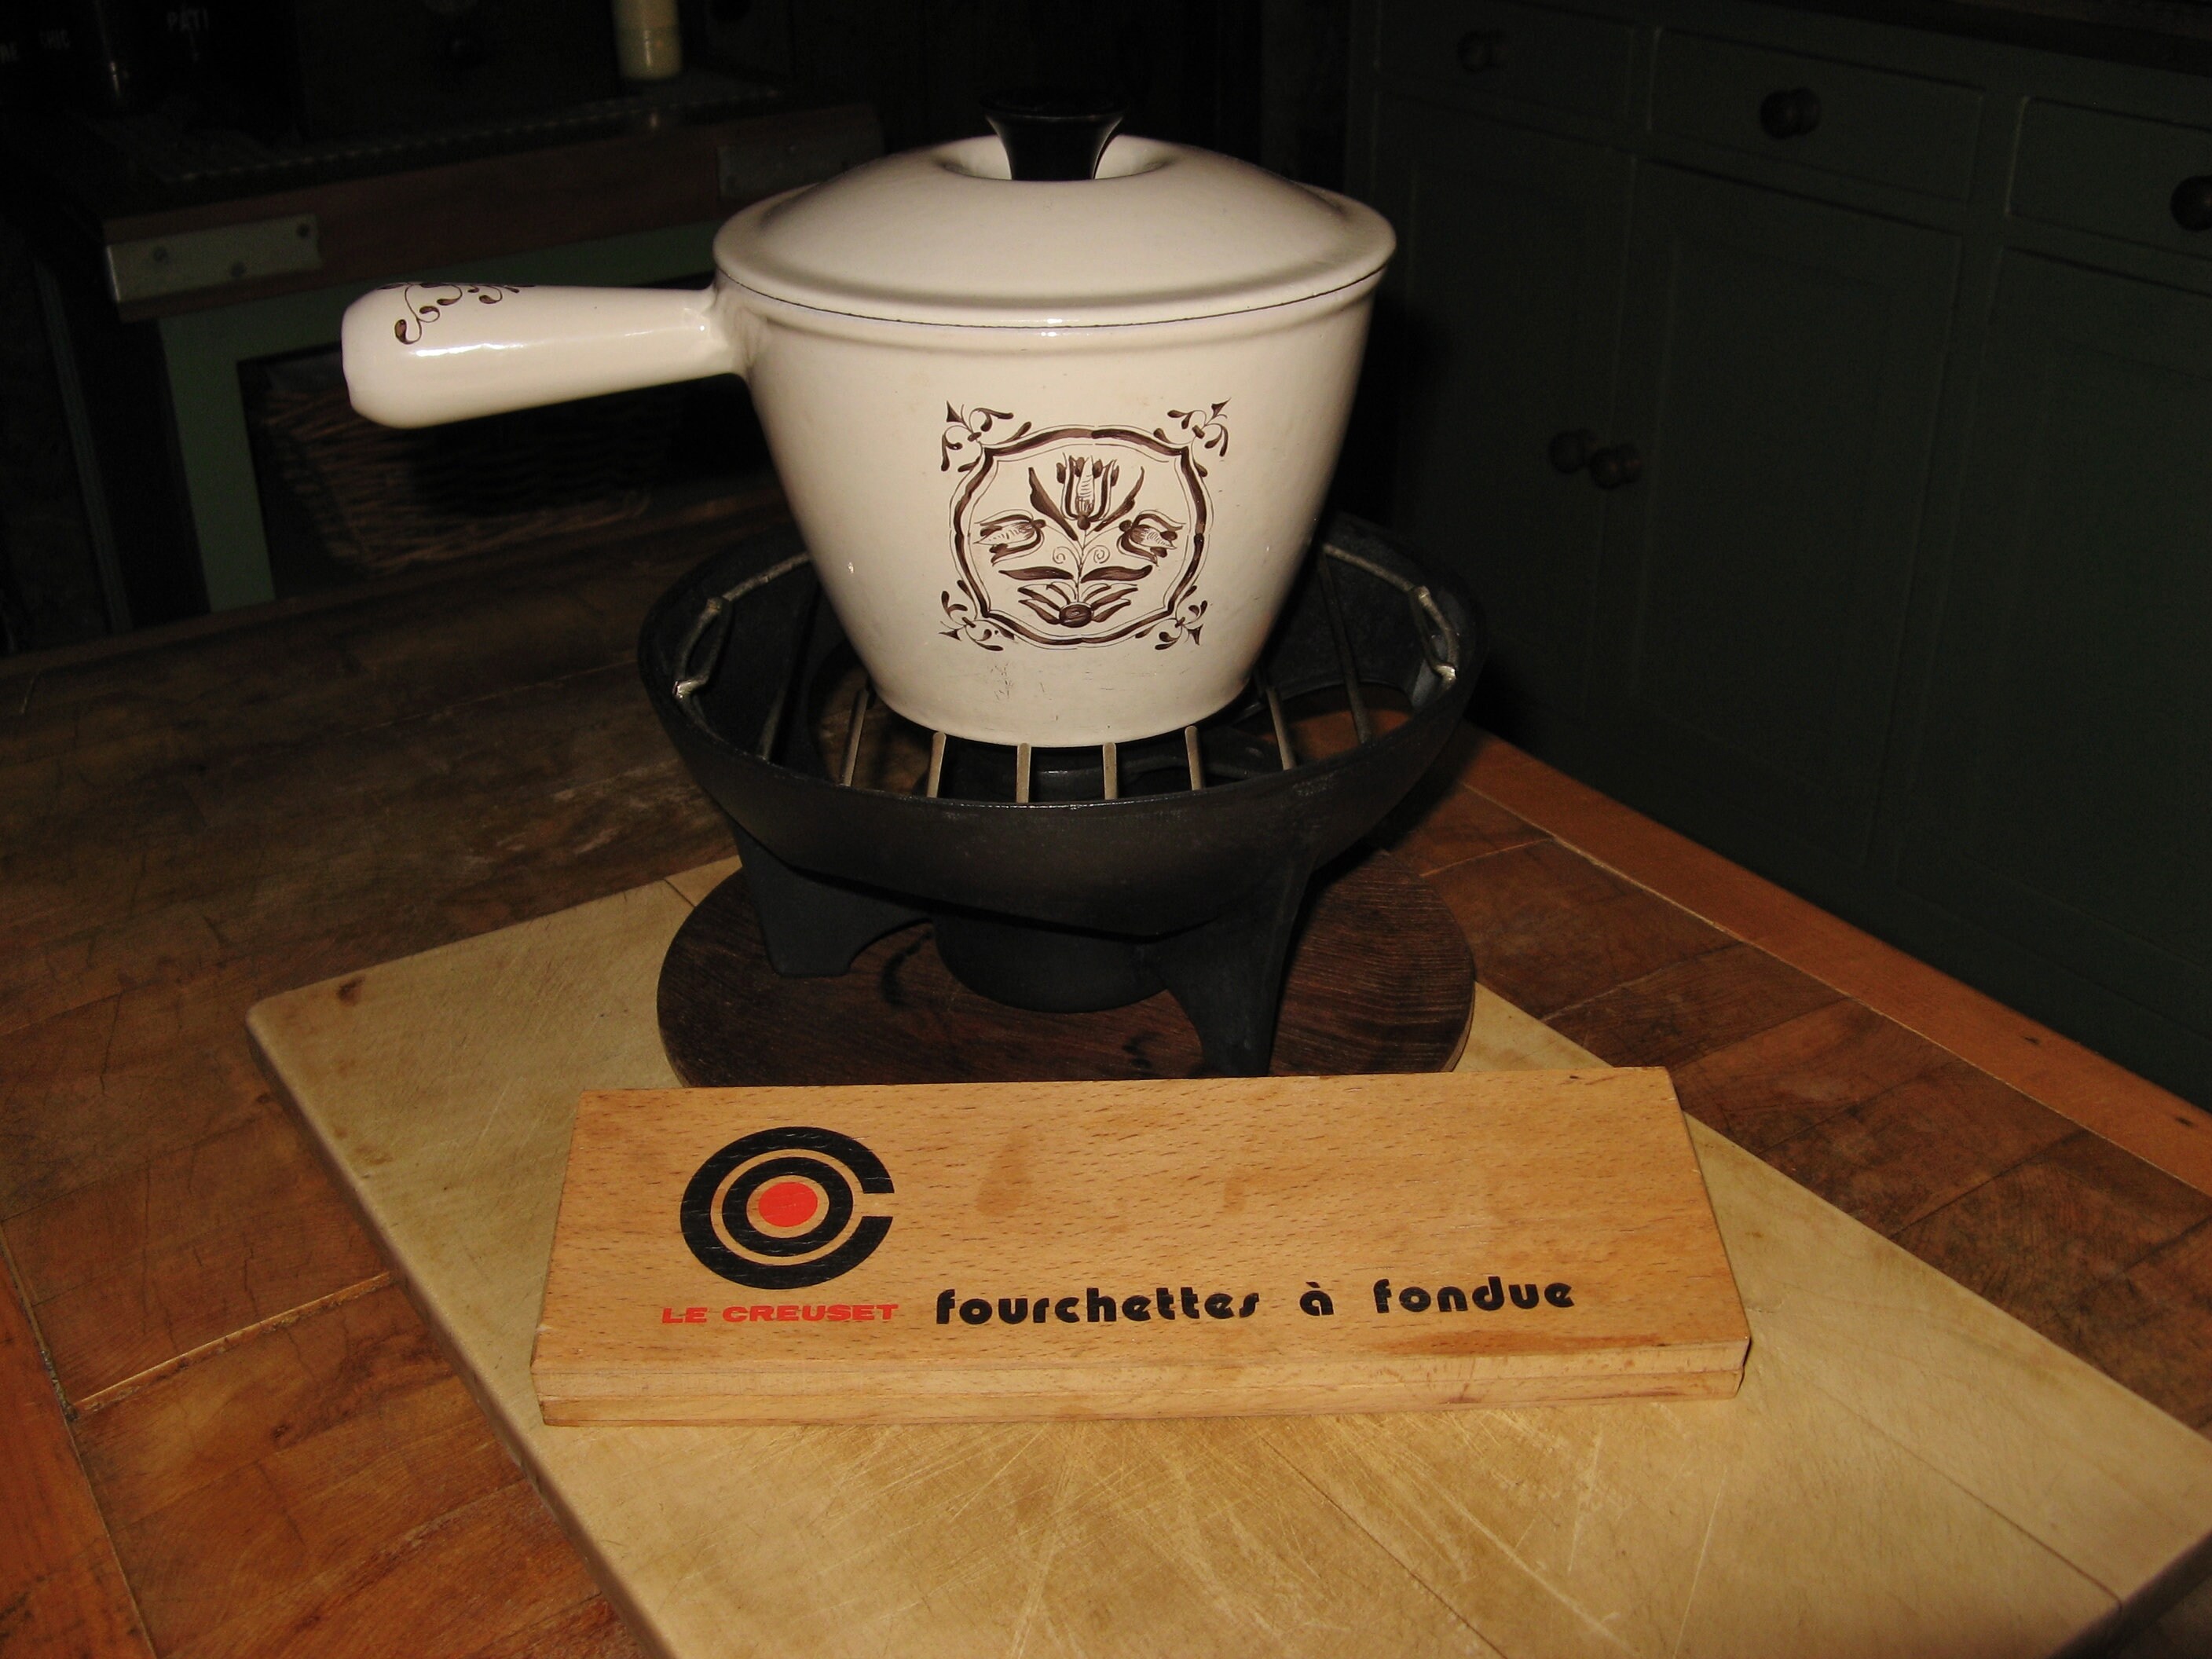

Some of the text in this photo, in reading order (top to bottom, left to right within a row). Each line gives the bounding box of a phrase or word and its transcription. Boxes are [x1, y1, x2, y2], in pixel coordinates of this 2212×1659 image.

[662, 1304, 899, 1324] LE CREUSET
[936, 1276, 1575, 1325] fourchettes à fondue
